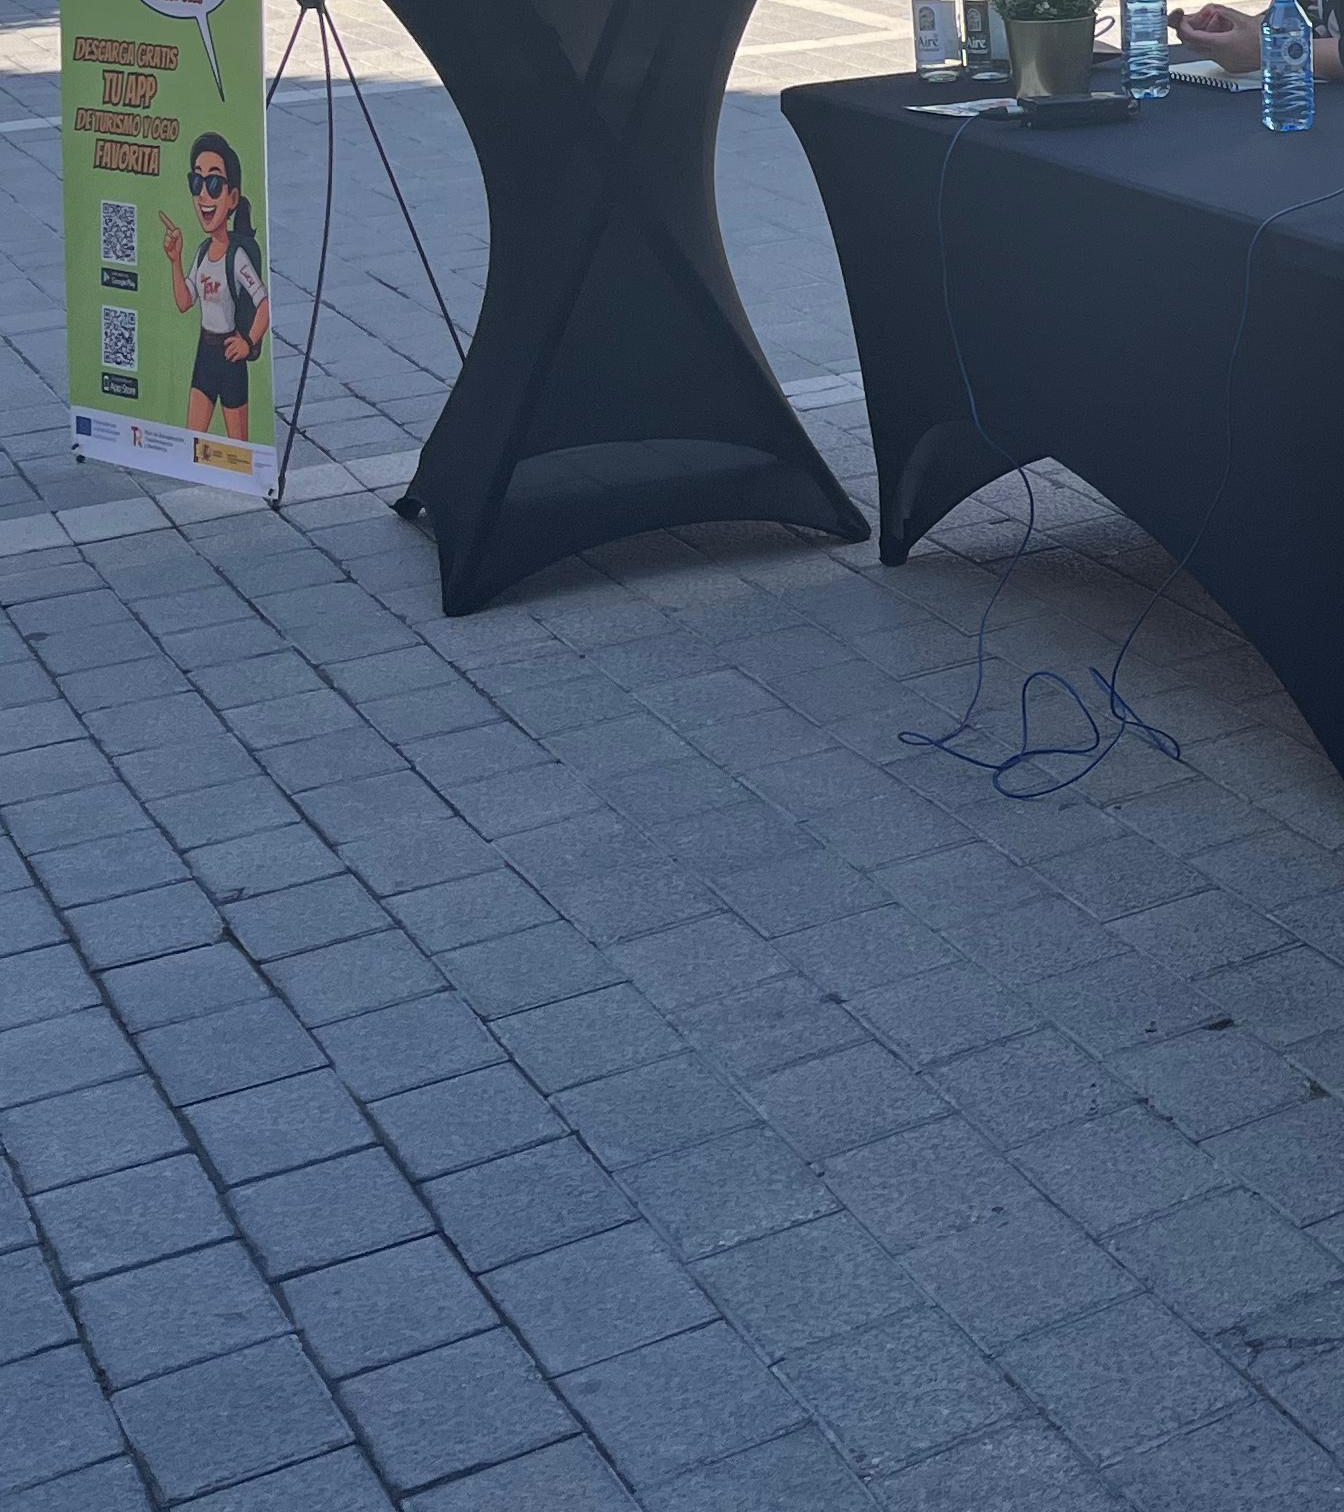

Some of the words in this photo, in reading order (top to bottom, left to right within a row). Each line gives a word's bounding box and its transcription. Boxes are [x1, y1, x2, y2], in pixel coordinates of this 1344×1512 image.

[73, 37, 136, 66] DESCARGA
[137, 43, 179, 71] GRATIS
[919, 35, 938, 48] Aire
[967, 36, 986, 48] Aire
[103, 69, 124, 106] TU
[123, 72, 158, 109] APP
[75, 108, 95, 131] DE
[94, 109, 141, 137] TURISMO
[142, 115, 152, 138] Y
[151, 116, 179, 142] OCIO
[93, 138, 160, 176] FAVORITA
